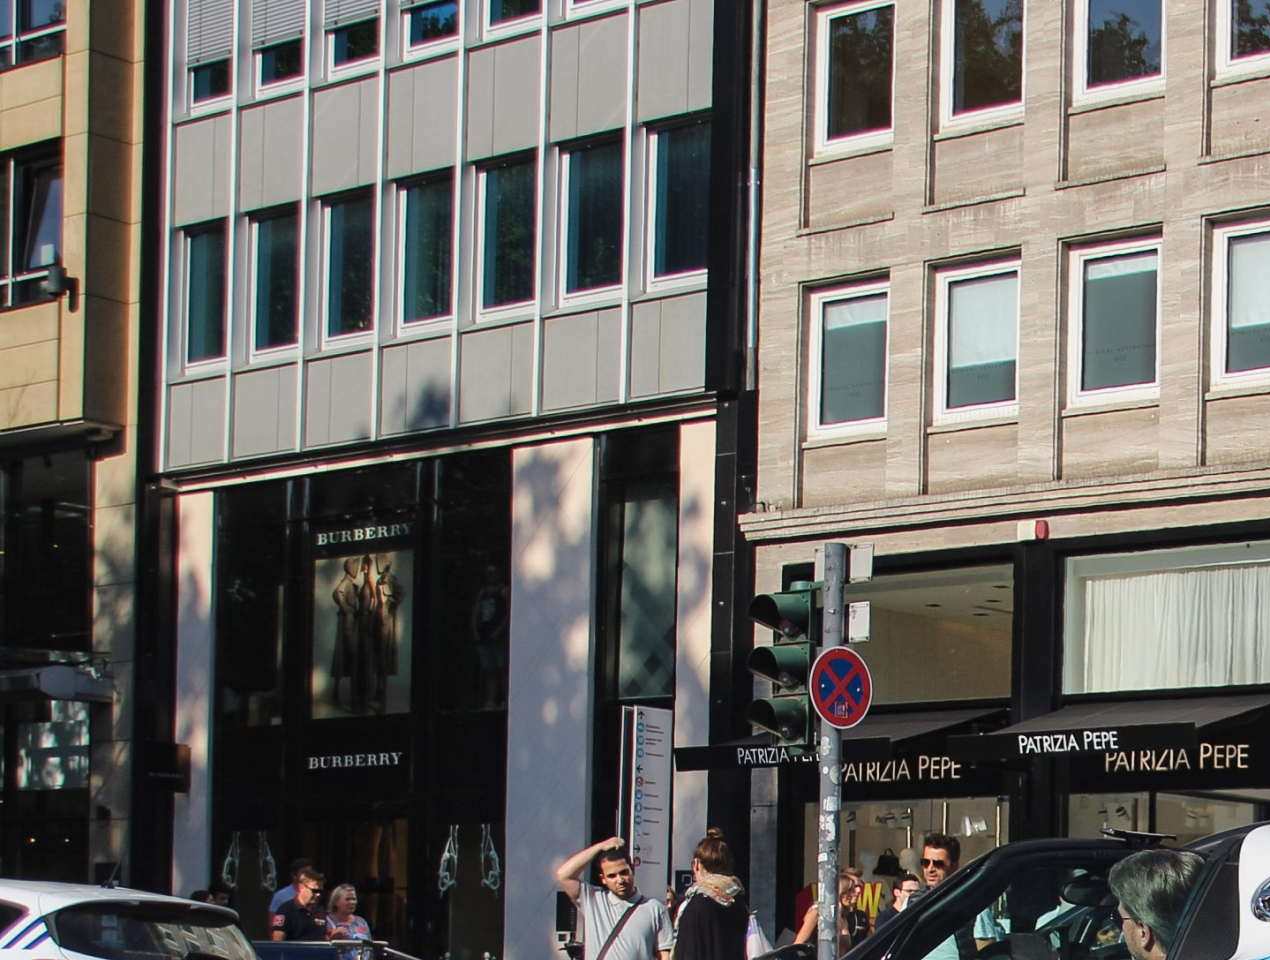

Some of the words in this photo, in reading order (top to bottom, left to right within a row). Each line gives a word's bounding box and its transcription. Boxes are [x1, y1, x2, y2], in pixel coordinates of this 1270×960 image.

[317, 523, 413, 546] BURBERRY
[1018, 734, 1080, 754] PATRIZIA
[1083, 731, 1119, 751] PEPE
[308, 752, 404, 769] BURBERRY
[737, 747, 790, 765] PATRIZIA
[918, 755, 962, 780] PEPE
[1105, 748, 1191, 772] PATRIZIA
[1199, 743, 1249, 769] PEPE
